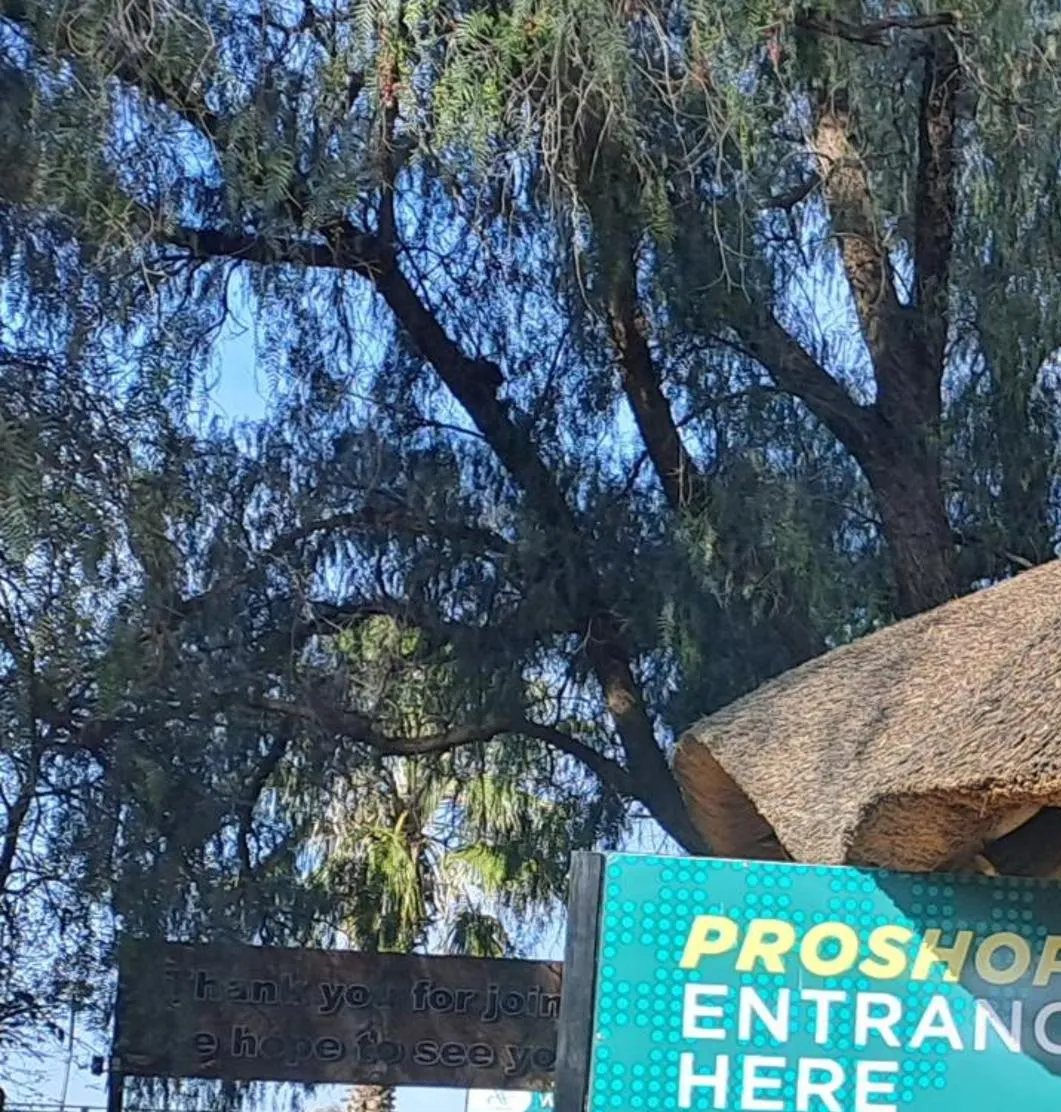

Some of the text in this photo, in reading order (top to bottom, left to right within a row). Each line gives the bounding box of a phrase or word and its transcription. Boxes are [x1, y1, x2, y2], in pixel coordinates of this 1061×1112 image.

[411, 977, 477, 1013] for
[231, 1024, 344, 1066] hope
[412, 1037, 496, 1067] see
